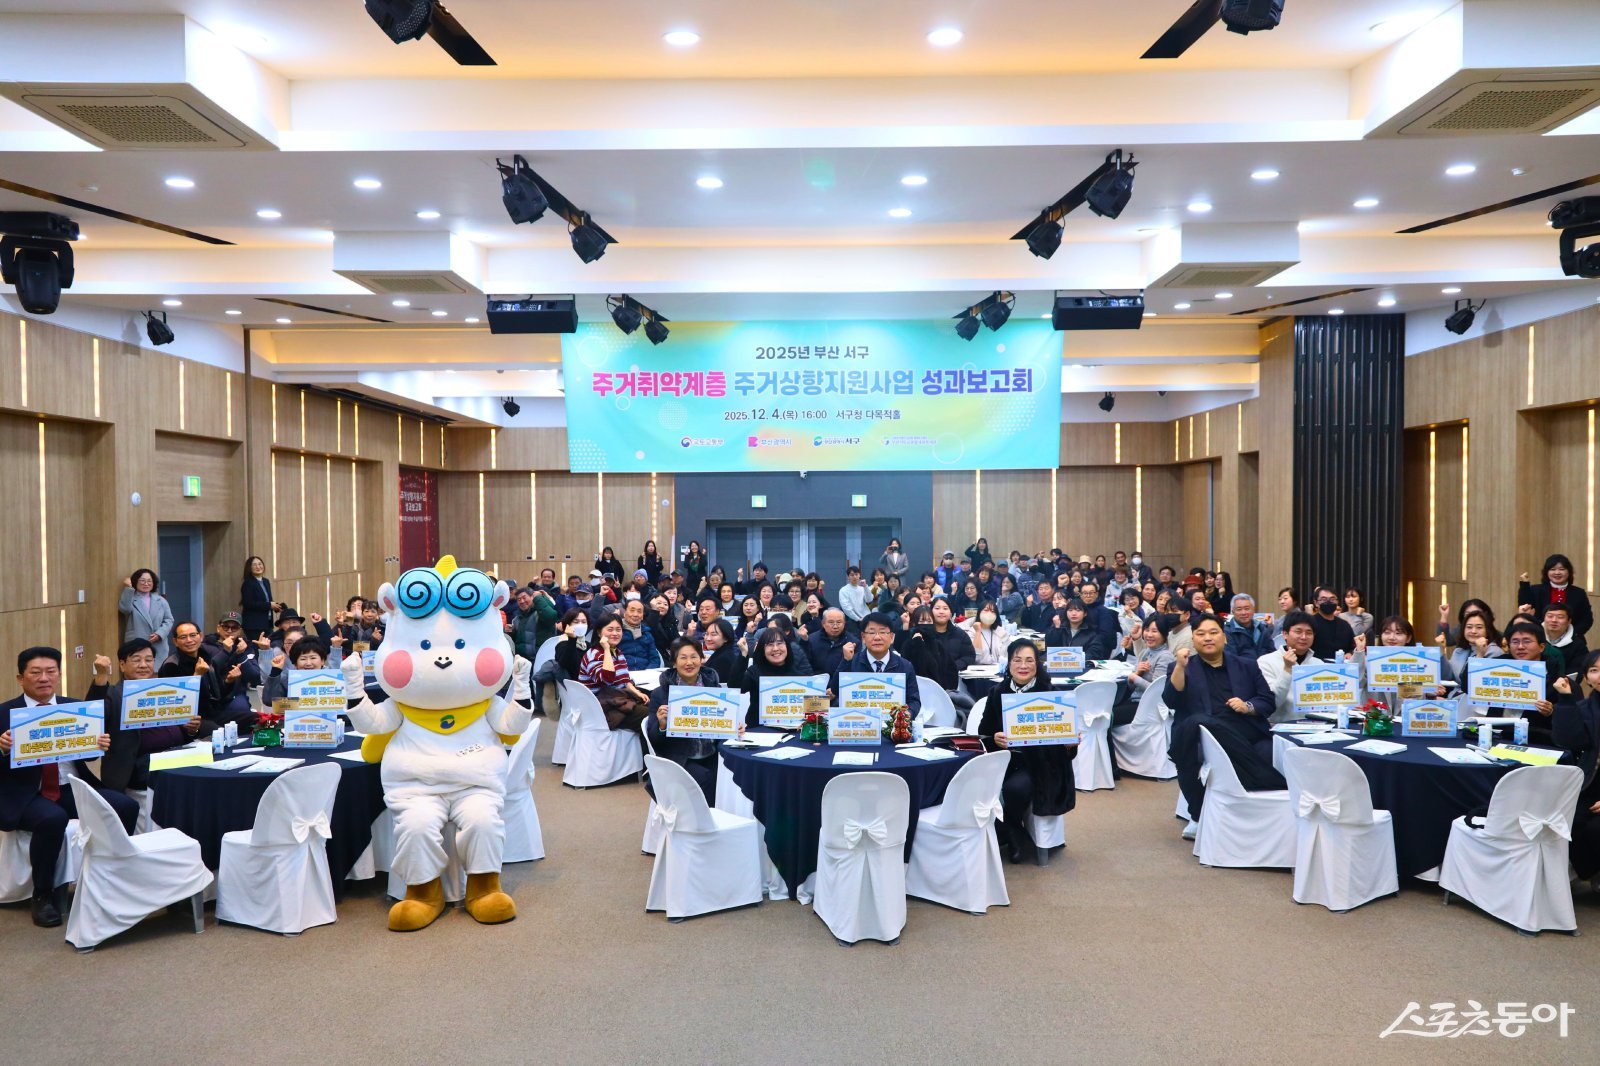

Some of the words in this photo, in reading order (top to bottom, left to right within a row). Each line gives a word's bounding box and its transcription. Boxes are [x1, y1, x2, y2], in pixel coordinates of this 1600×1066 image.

[756, 346, 810, 360] 2025년
[814, 346, 840, 359] 부산
[844, 346, 869, 359] 서구
[592, 371, 726, 397] 주거취약계층
[734, 370, 914, 396] 주거상향지원사업
[922, 368, 1033, 395] 성과보고회
[802, 410, 828, 419] 16:00
[836, 409, 862, 420] 서구청
[866, 409, 901, 420] 다목적홀
[29, 728, 52, 740] 함께
[54, 724, 88, 737] 만드는
[20, 740, 53, 754] 따뜻한
[56, 735, 97, 750] 주거복지
